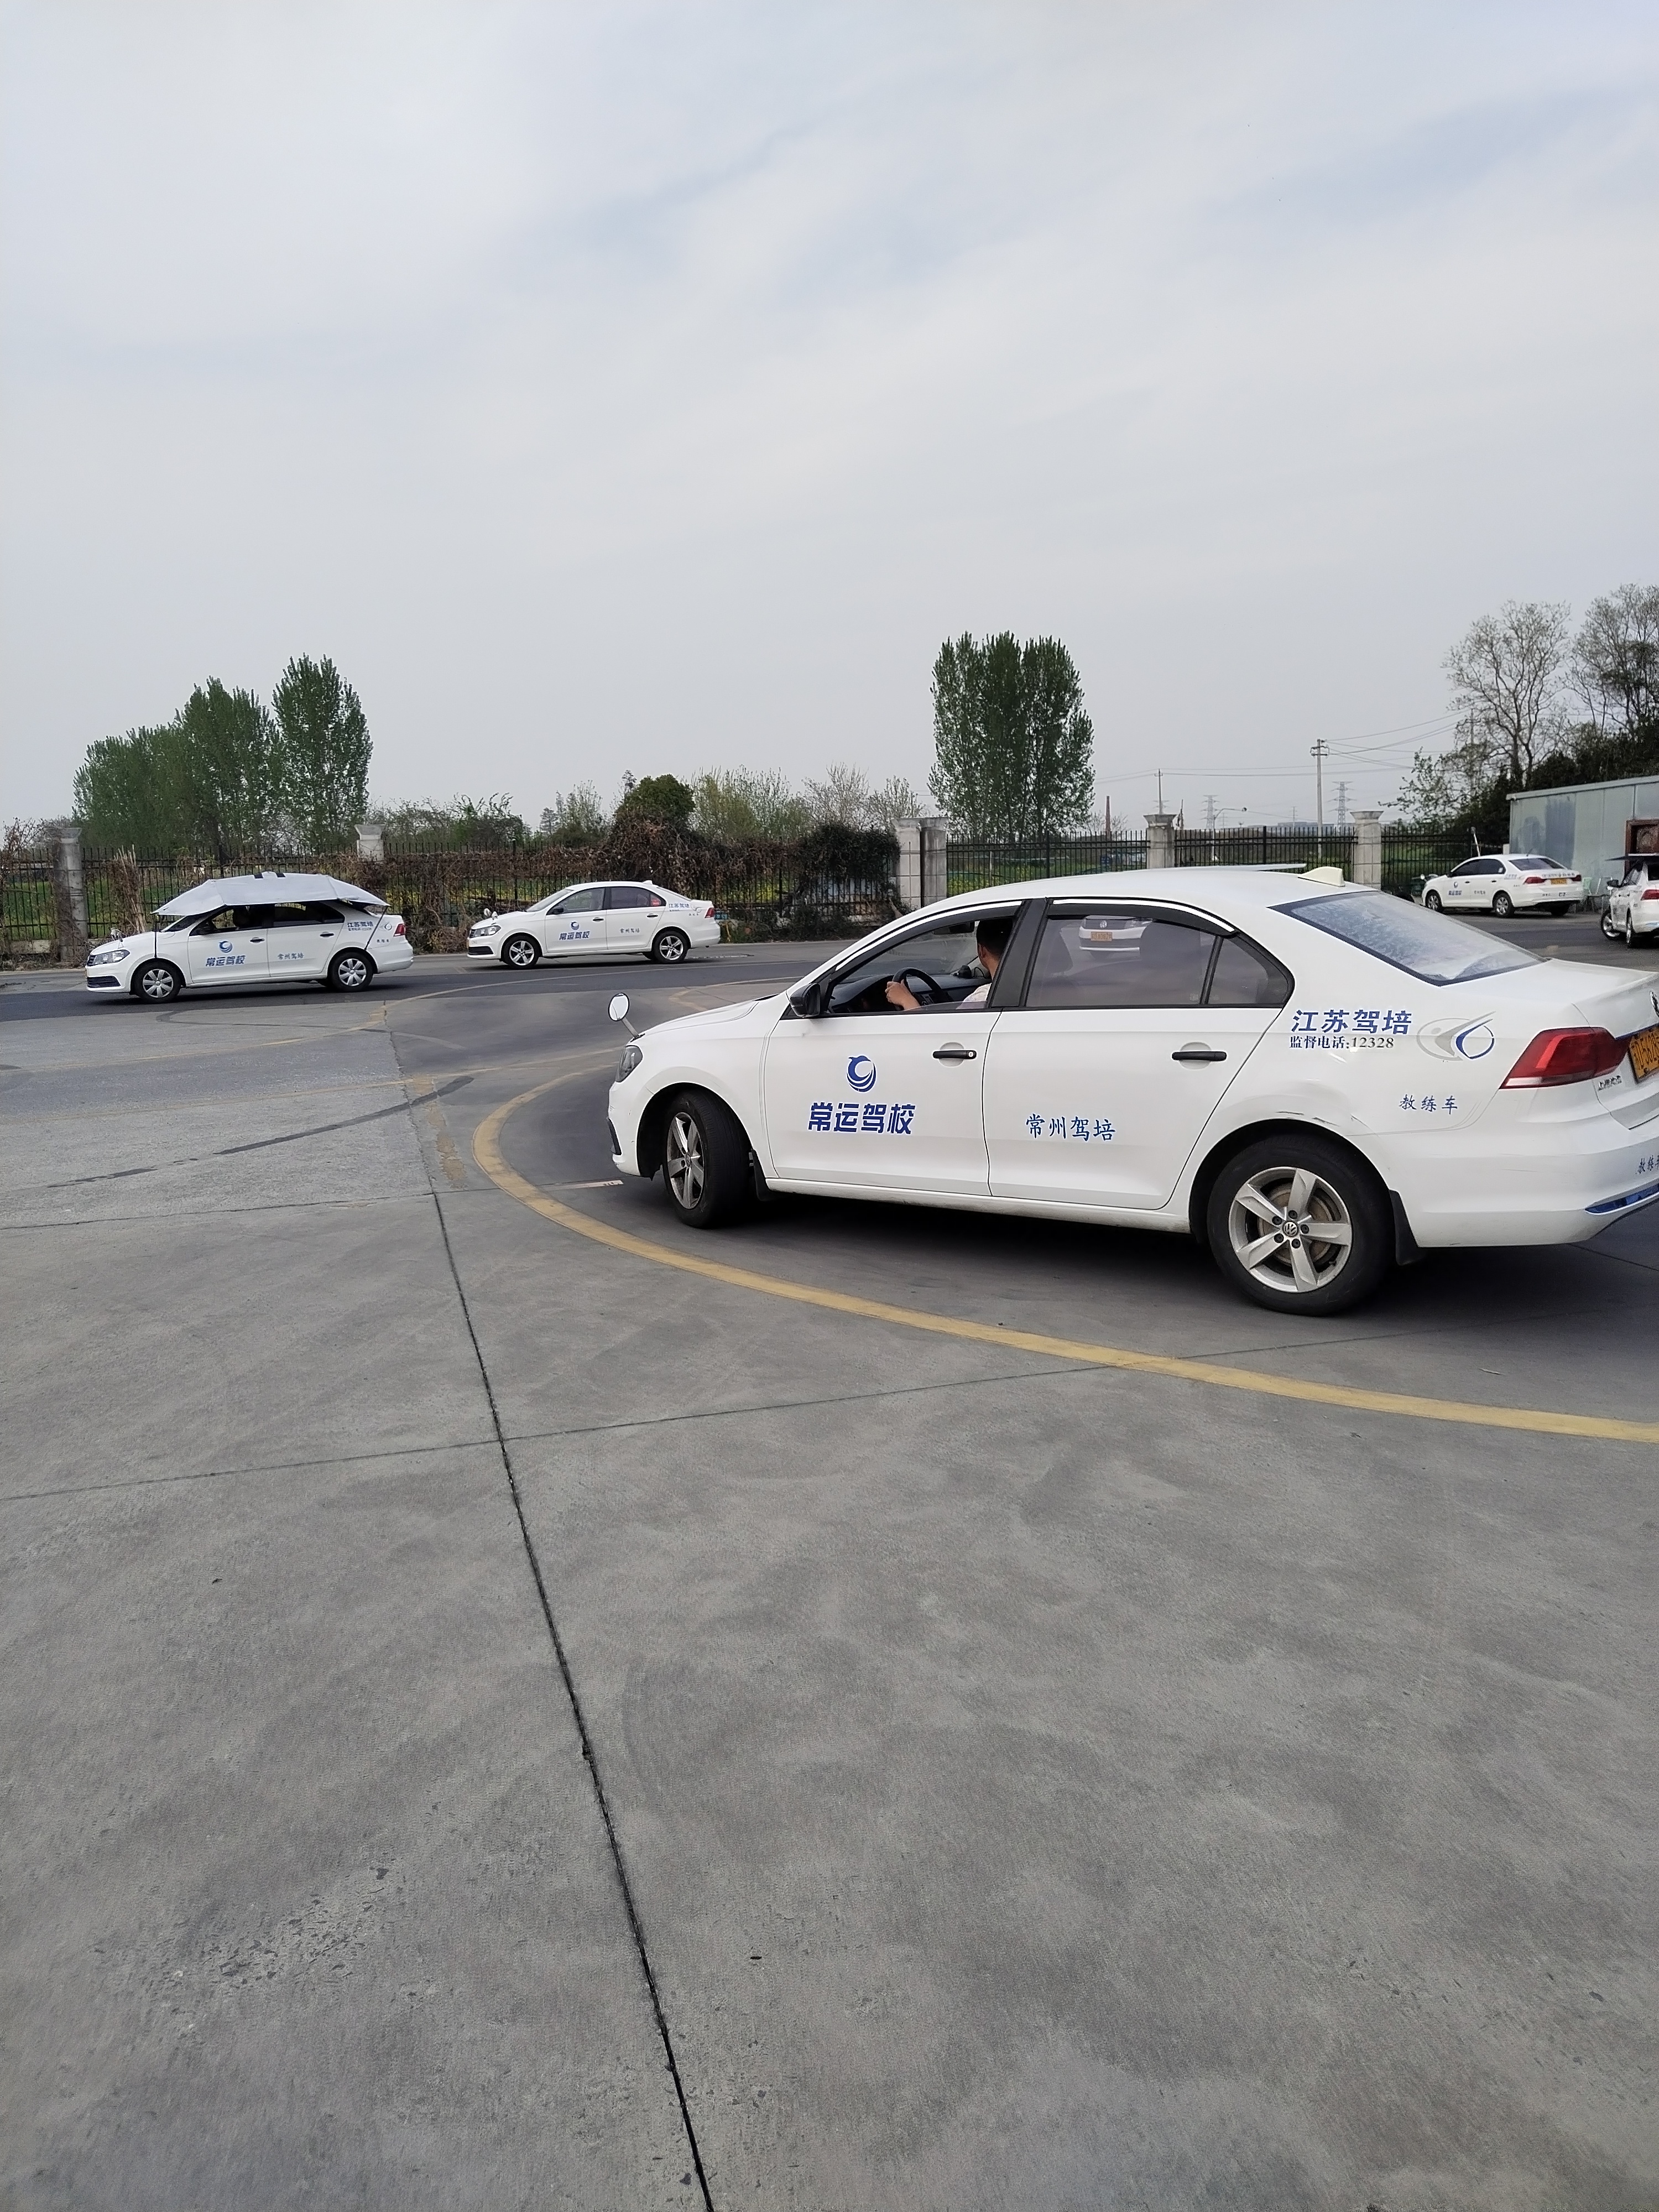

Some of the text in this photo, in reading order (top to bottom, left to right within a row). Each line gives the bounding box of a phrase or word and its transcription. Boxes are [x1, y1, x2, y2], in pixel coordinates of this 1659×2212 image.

[559, 931, 590, 940] 常运驾校
[205, 955, 246, 967] 常运驾校
[1291, 1009, 1412, 1035] 江苏驾培
[1290, 1036, 1394, 1049] 监督电话:12328
[1399, 1094, 1458, 1115] 教练车
[808, 1102, 916, 1134] 常运驾校
[1026, 1113, 1116, 1141] 常州驾培
